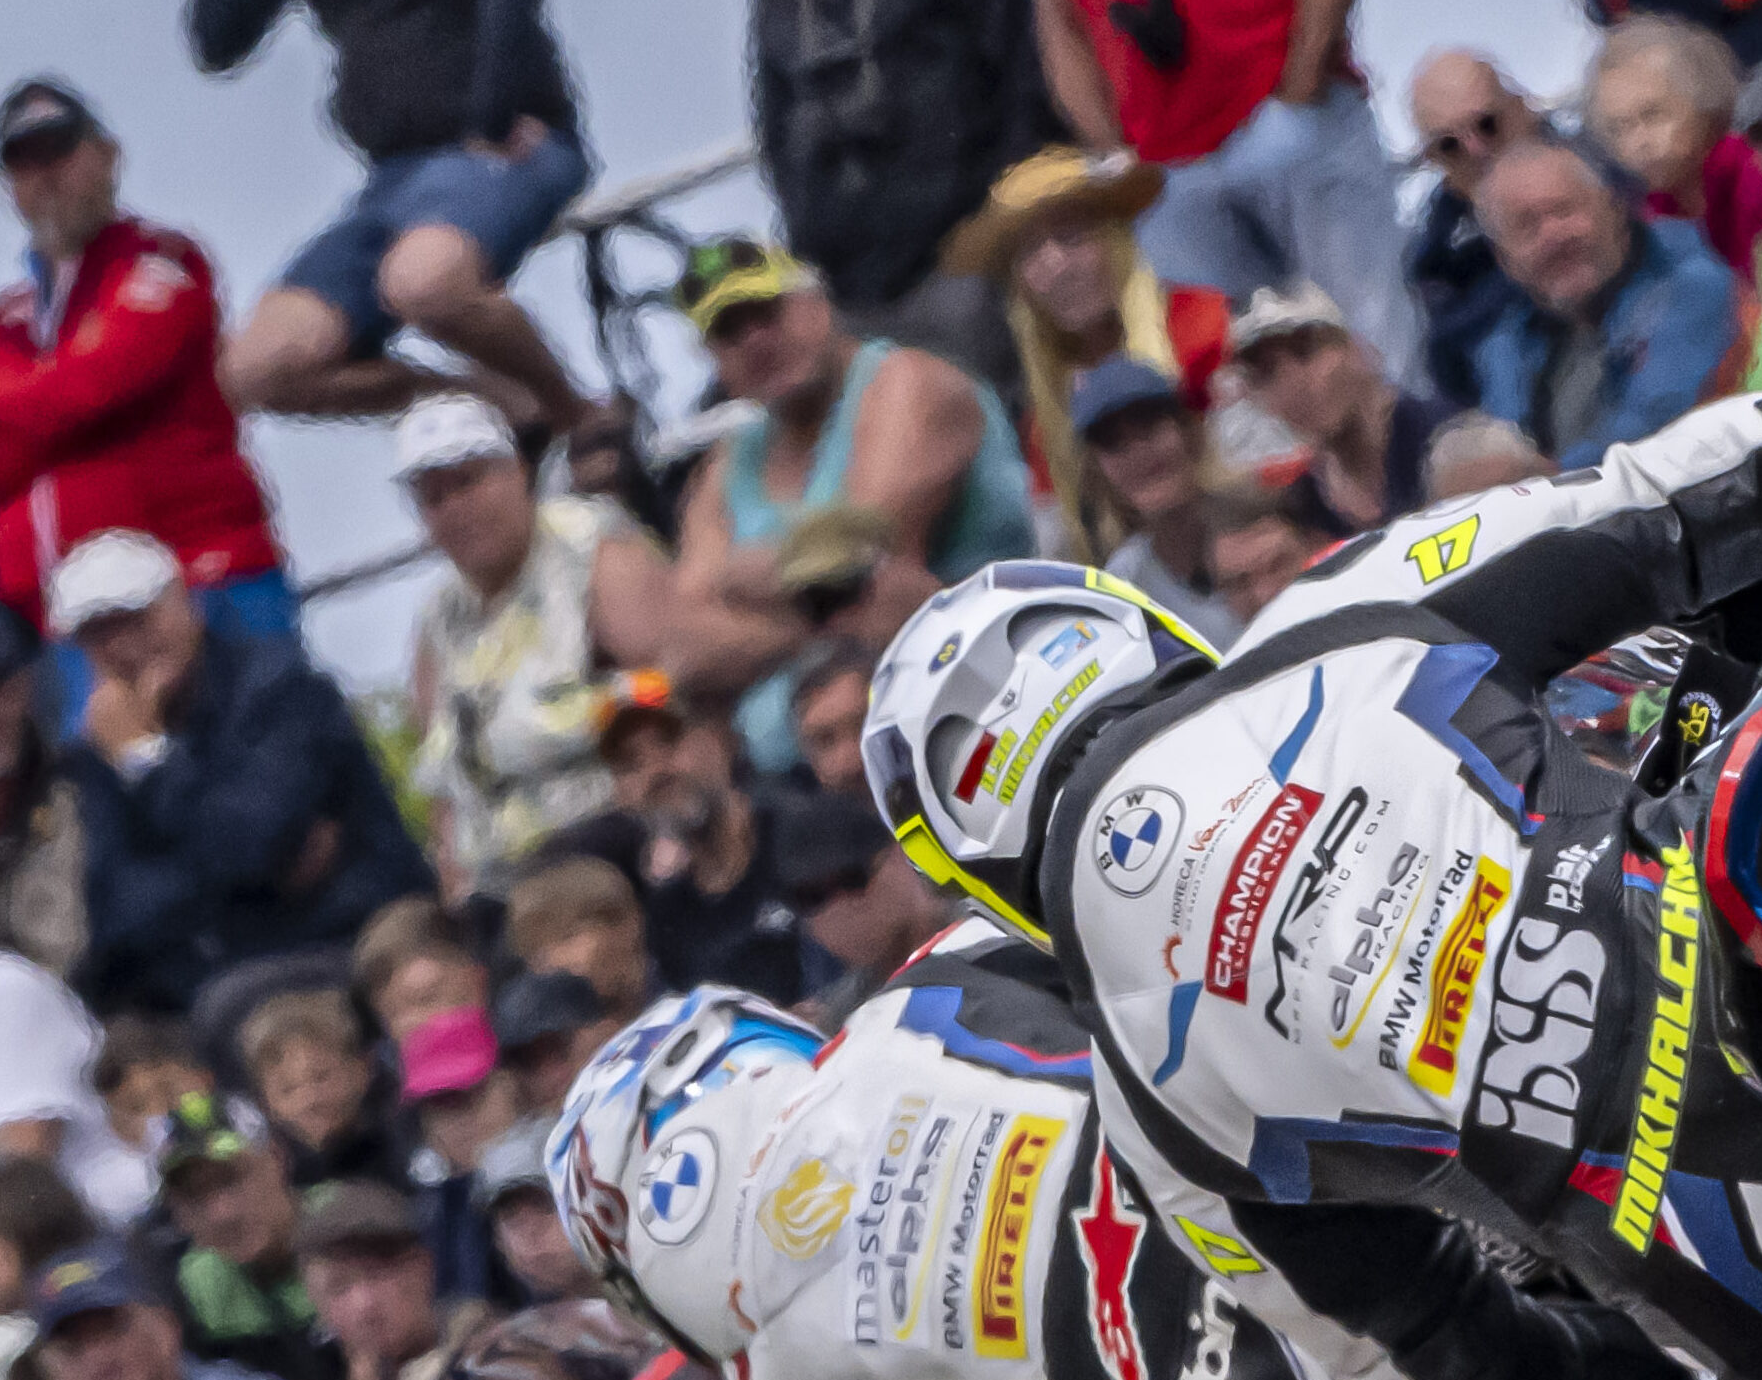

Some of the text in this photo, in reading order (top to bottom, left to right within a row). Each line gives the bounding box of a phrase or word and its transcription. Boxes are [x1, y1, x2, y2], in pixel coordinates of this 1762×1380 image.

[1405, 514, 1481, 585] 17
[1215, 797, 1302, 989] CHAMPION
[1329, 841, 1420, 1032] alpha
[1374, 855, 1430, 959] RACING
[1379, 849, 1474, 1071] BMW Motorrad
[1416, 873, 1505, 1073] PIRELLI
[886, 1117, 950, 1322] alpha
[943, 1112, 1005, 1350] BMW Motorrad
[981, 1130, 1048, 1341] PIRELLI
